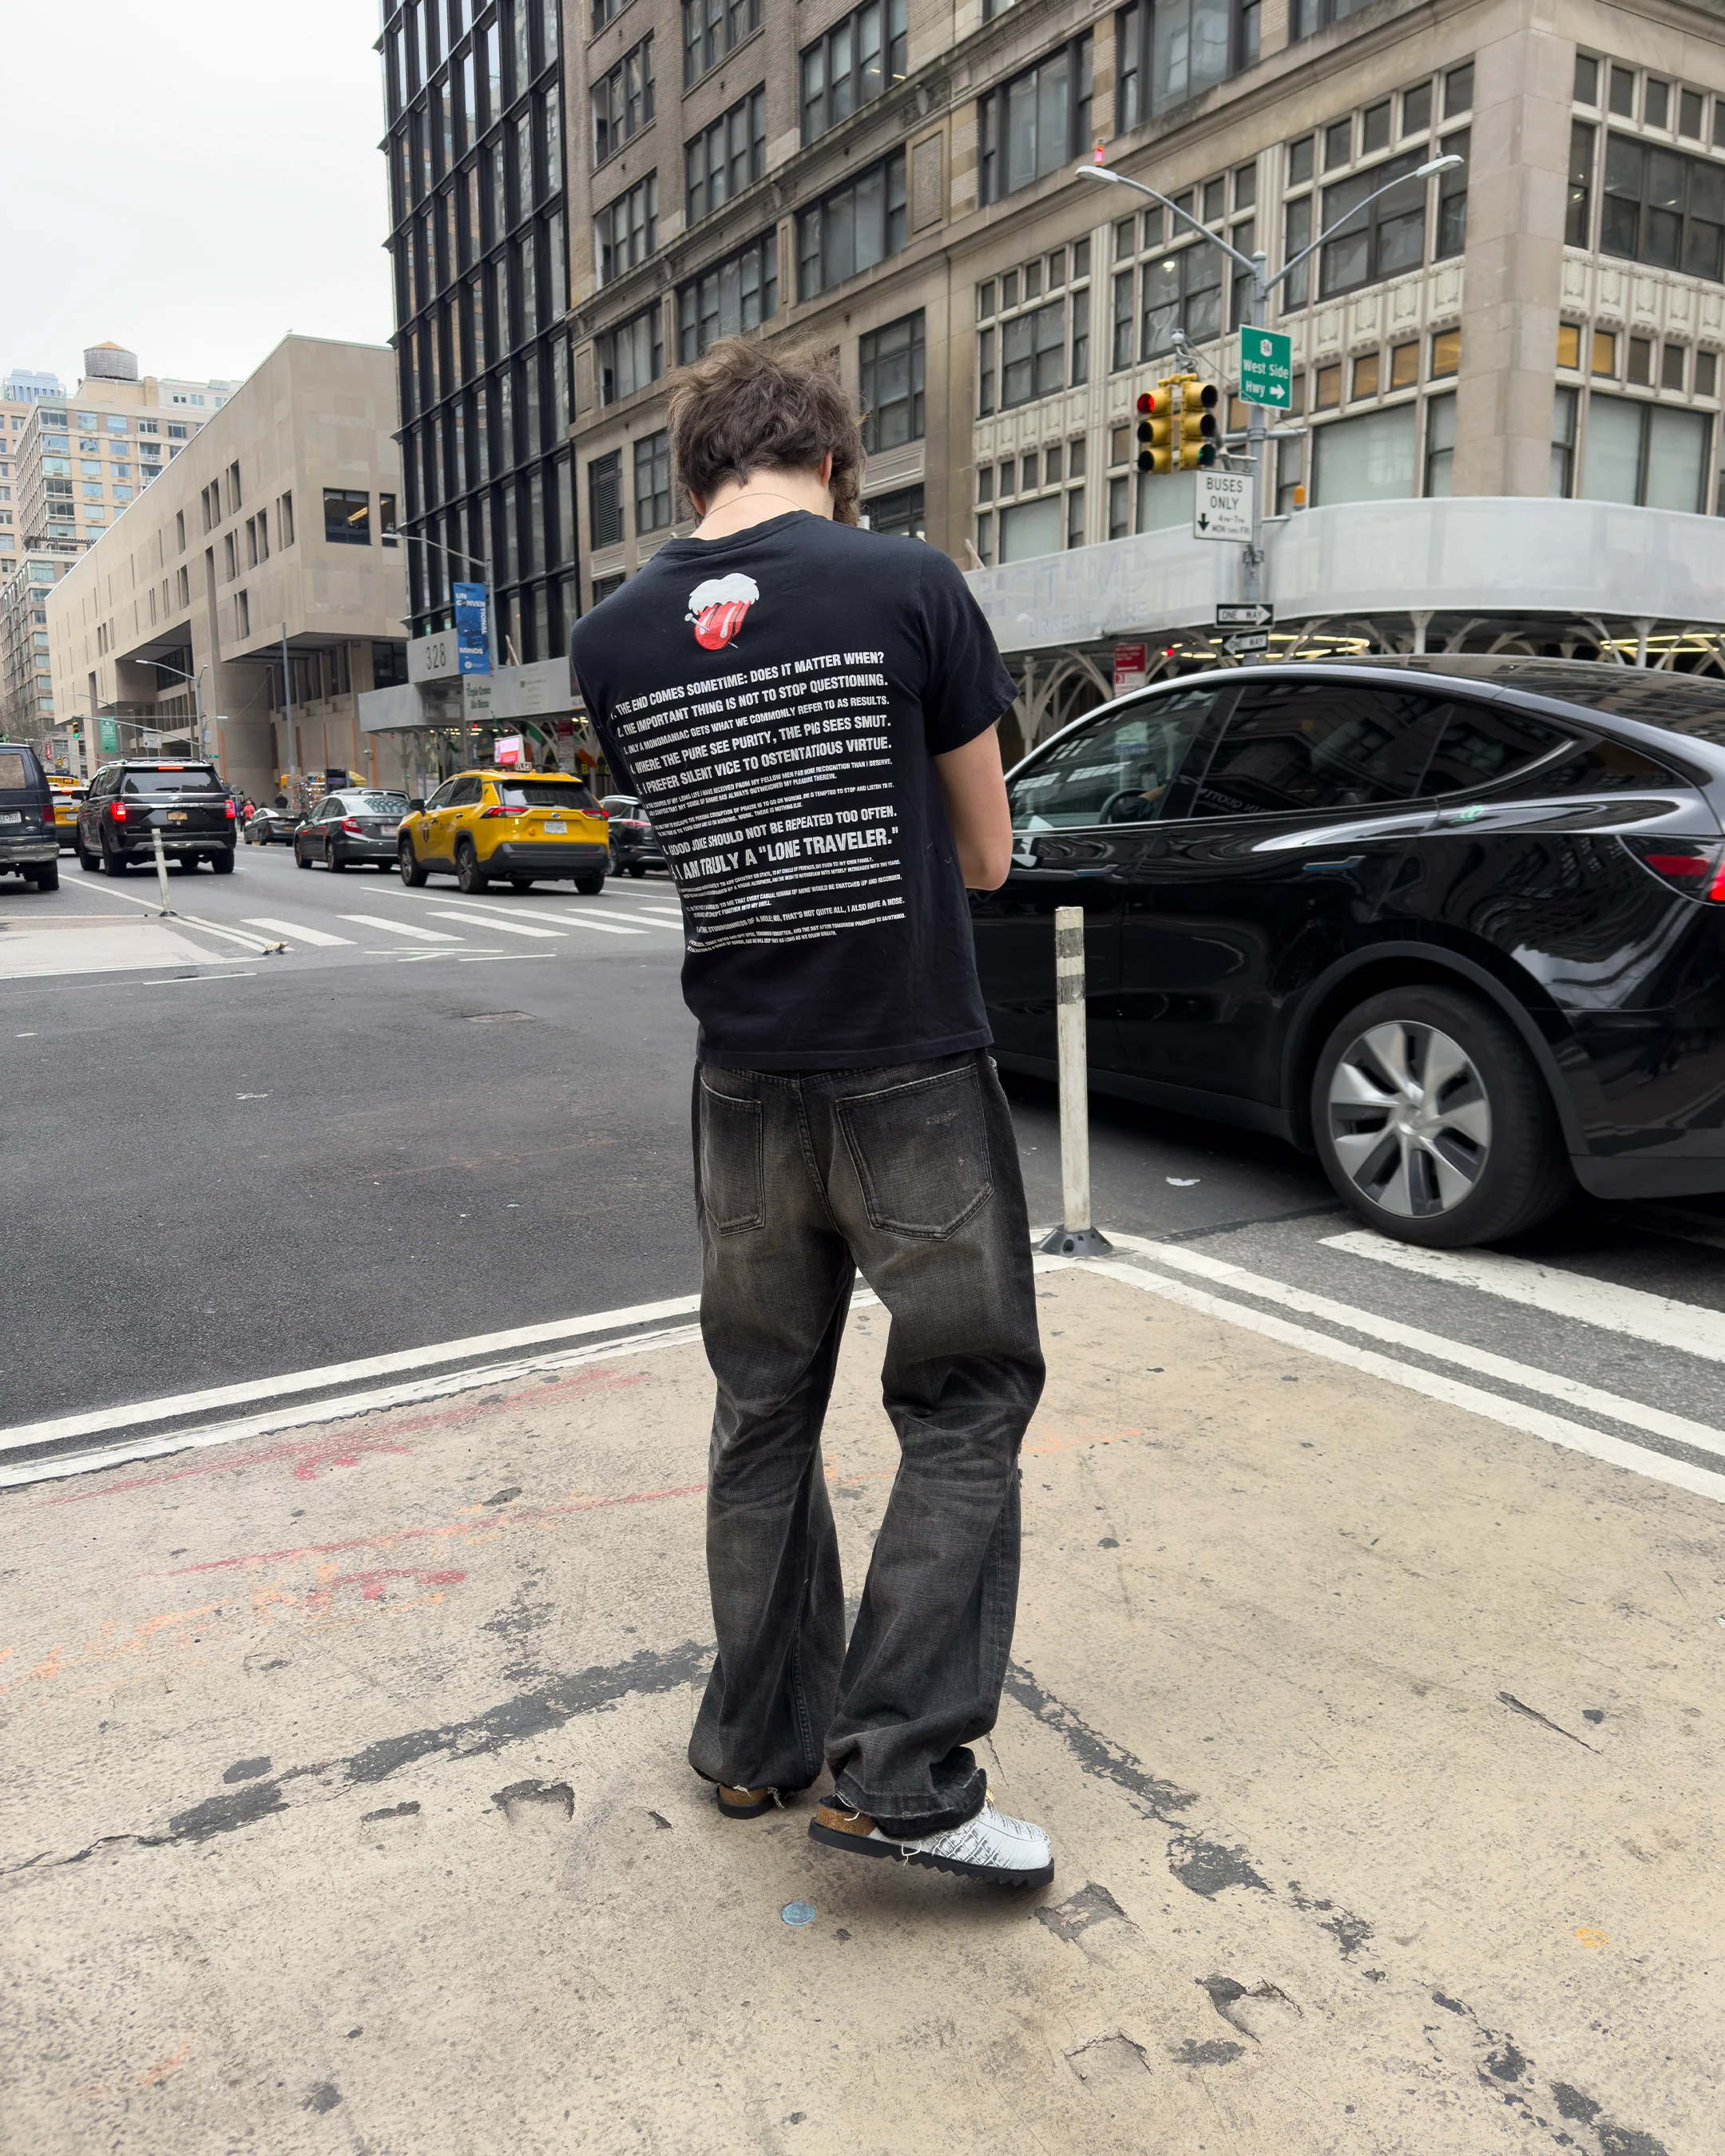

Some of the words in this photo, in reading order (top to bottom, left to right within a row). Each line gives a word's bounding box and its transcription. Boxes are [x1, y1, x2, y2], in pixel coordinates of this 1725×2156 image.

[1243, 359, 1266, 375] West
[1268, 363, 1289, 379] Side
[1246, 379, 1265, 398] Hwy
[1207, 477, 1243, 493] BUSES
[1210, 495, 1239, 509] ONLY
[1212, 525, 1226, 533] MON
[1222, 610, 1237, 620] ONE
[426, 642, 446, 670] 328
[1230, 640, 1243, 649] ONE
[1250, 637, 1263, 647] WAY
[616, 702, 632, 715] THE
[631, 696, 648, 711] END
[649, 686, 685, 706] COMES
[686, 672, 748, 696] SOMETIME:
[749, 666, 779, 683] DOES
[780, 663, 791, 676] IT
[794, 653, 842, 674] MATTER
[843, 652, 884, 665] WHEN?
[623, 723, 637, 735] THE
[636, 707, 689, 733] IMPORTANT
[691, 700, 724, 717] THING
[725, 696, 737, 710] IS
[738, 692, 759, 707] NOT
[761, 688, 777, 703] TO
[778, 683, 807, 700] STOP
[809, 673, 888, 694] QUESTIONING.
[628, 743, 639, 754] ONLY
[638, 743, 644, 751] A
[643, 729, 690, 751] MONOMANIAC
[689, 724, 711, 738] GETS
[711, 719, 734, 733] WHAT
[735, 716, 749, 727] WE
[749, 707, 795, 724] COMMONLY
[797, 702, 823, 715] REFER
[823, 700, 835, 710] TO
[837, 697, 849, 708] AS
[850, 696, 890, 707] RESULTS.
[634, 757, 662, 774] WHERE
[660, 751, 681, 767] THE
[680, 744, 708, 762] PURE
[709, 739, 731, 755] SEE
[732, 731, 777, 751] PURITY,
[778, 725, 803, 741] THE
[803, 721, 821, 736] PIG
[823, 716, 852, 733] SEES
[854, 715, 891, 730] SMUT.
[642, 782, 648, 795] I
[645, 775, 680, 793] PREFER
[680, 766, 713, 786] SILENT
[714, 759, 742, 777] VICE
[742, 755, 759, 771] TO
[760, 740, 844, 767] OSTENTATIOUS
[846, 736, 892, 753] VIRTUE.
[678, 794, 692, 803] LONG
[692, 790, 701, 799] LIFE
[703, 787, 713, 796] HAVE
[713, 783, 735, 795] RECEIVED
[735, 780, 751, 790] FROM
[751, 778, 760, 787] MY
[760, 773, 782, 784] FELLOW
[782, 771, 794, 779] MEN
[794, 768, 804, 777] FAR
[803, 767, 815, 775] MORE
[815, 762, 851, 773] RECOGNITION
[869, 758, 893, 767] DESERVE,
[668, 805, 678, 814] THAT
[687, 799, 700, 808] SENSE
[705, 795, 719, 804] SHAME
[718, 793, 728, 802] HAS
[728, 789, 749, 799] ALWAYS
[749, 782, 783, 795] OUTWEIGHED
[792, 775, 814, 786] PLEASURE
[813, 773, 838, 782] THEREIN.
[815, 789, 836, 798] TEMPTED
[692, 836, 708, 852] JOKE
[708, 830, 744, 848] SHOULD
[744, 824, 767, 840] NOT
[769, 821, 784, 835] BE
[785, 813, 834, 832] REPEATED
[835, 810, 859, 824] TOO
[860, 805, 898, 822] OFTEN.
[675, 864, 684, 880] I
[683, 859, 700, 880] AM
[700, 851, 740, 876] TRULY
[745, 848, 758, 866] A
[758, 839, 801, 862] "LONE
[803, 826, 899, 856] TRAVELER."
[734, 896, 747, 905] THAT
[746, 894, 759, 903] EVERY
[759, 891, 776, 901] CASUAL
[835, 881, 861, 890] SNATCHED
[878, 874, 902, 884] RECORDED,
[708, 919, 748, 933] STUBBORNNESS
[782, 911, 803, 921] THAT'S
[815, 907, 833, 917] QUITE
[833, 906, 847, 914] ALL,
[851, 903, 866, 912] ALSO
[866, 900, 881, 910] HAVE
[887, 897, 906, 906] NOSE.
